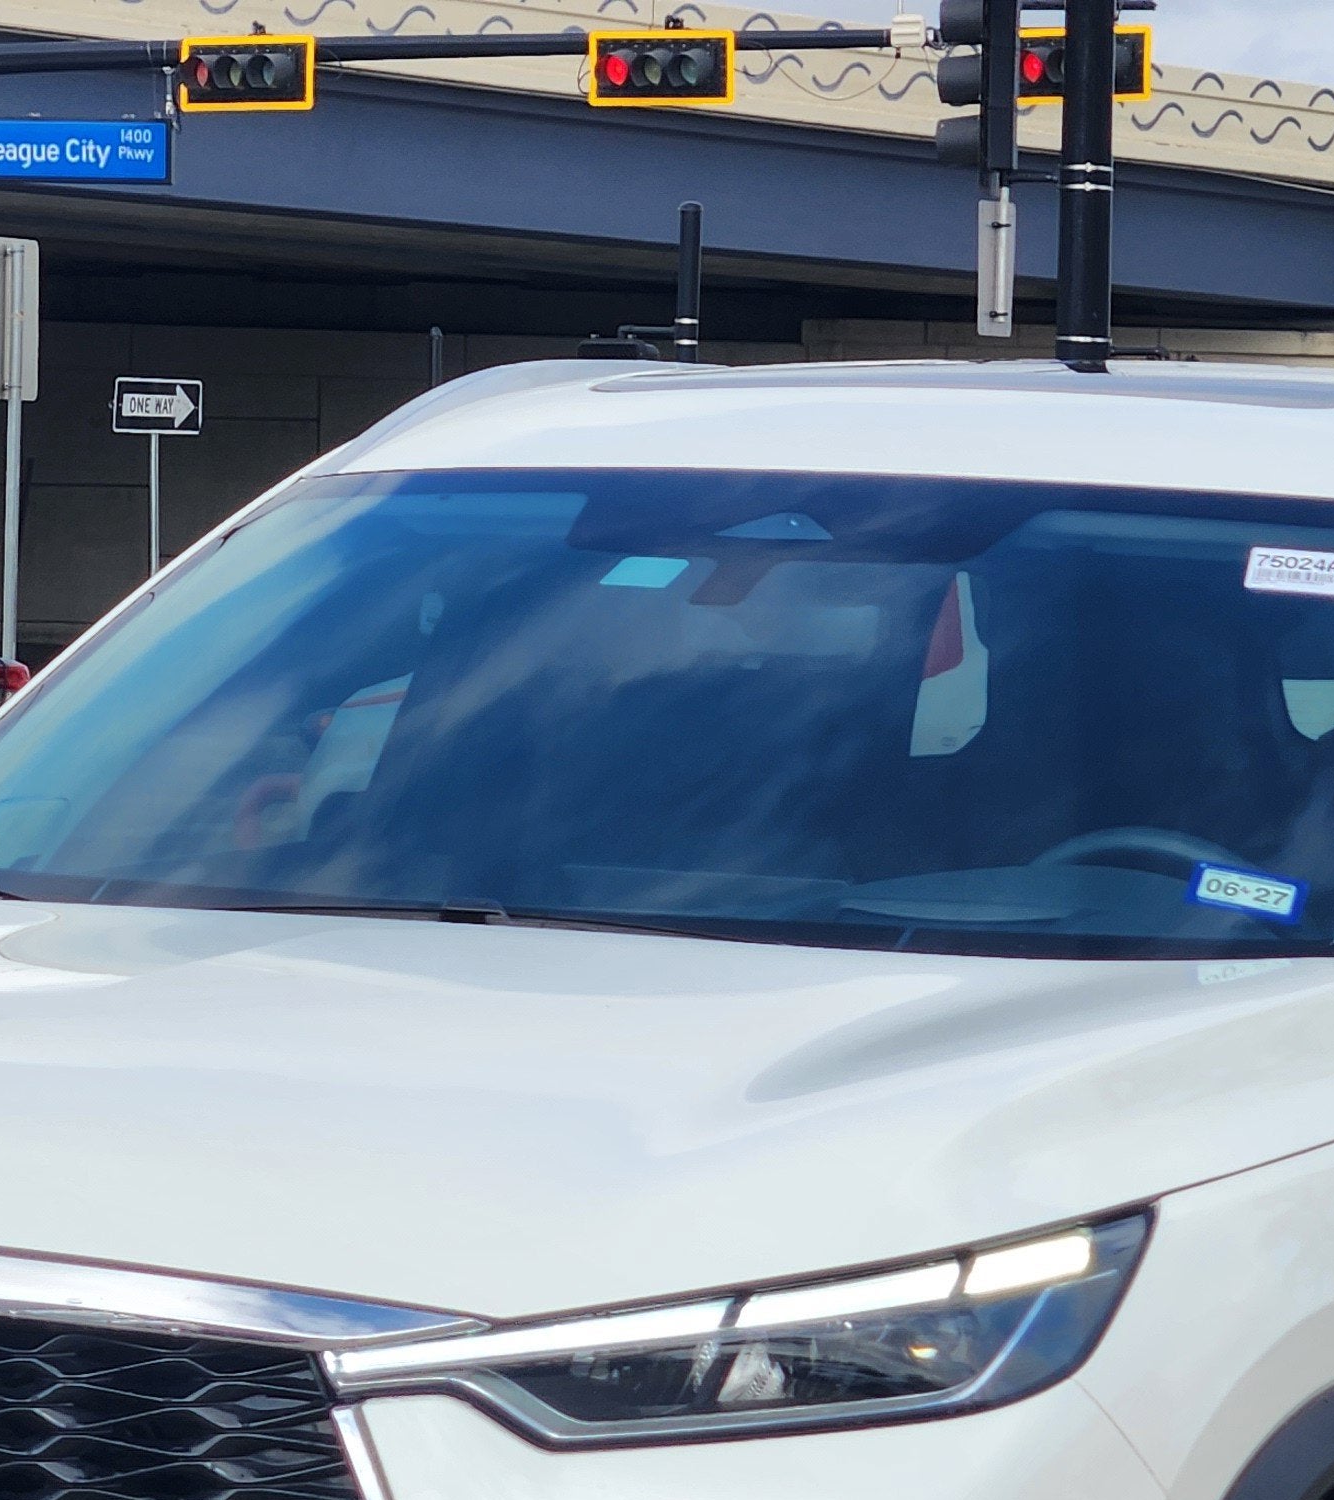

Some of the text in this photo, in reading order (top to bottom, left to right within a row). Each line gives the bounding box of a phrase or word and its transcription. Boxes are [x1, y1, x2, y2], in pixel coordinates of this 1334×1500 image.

[120, 129, 152, 144] 1400
[66, 138, 110, 168] City
[119, 146, 154, 162] Pkwy
[129, 396, 175, 414] ONE WAY
